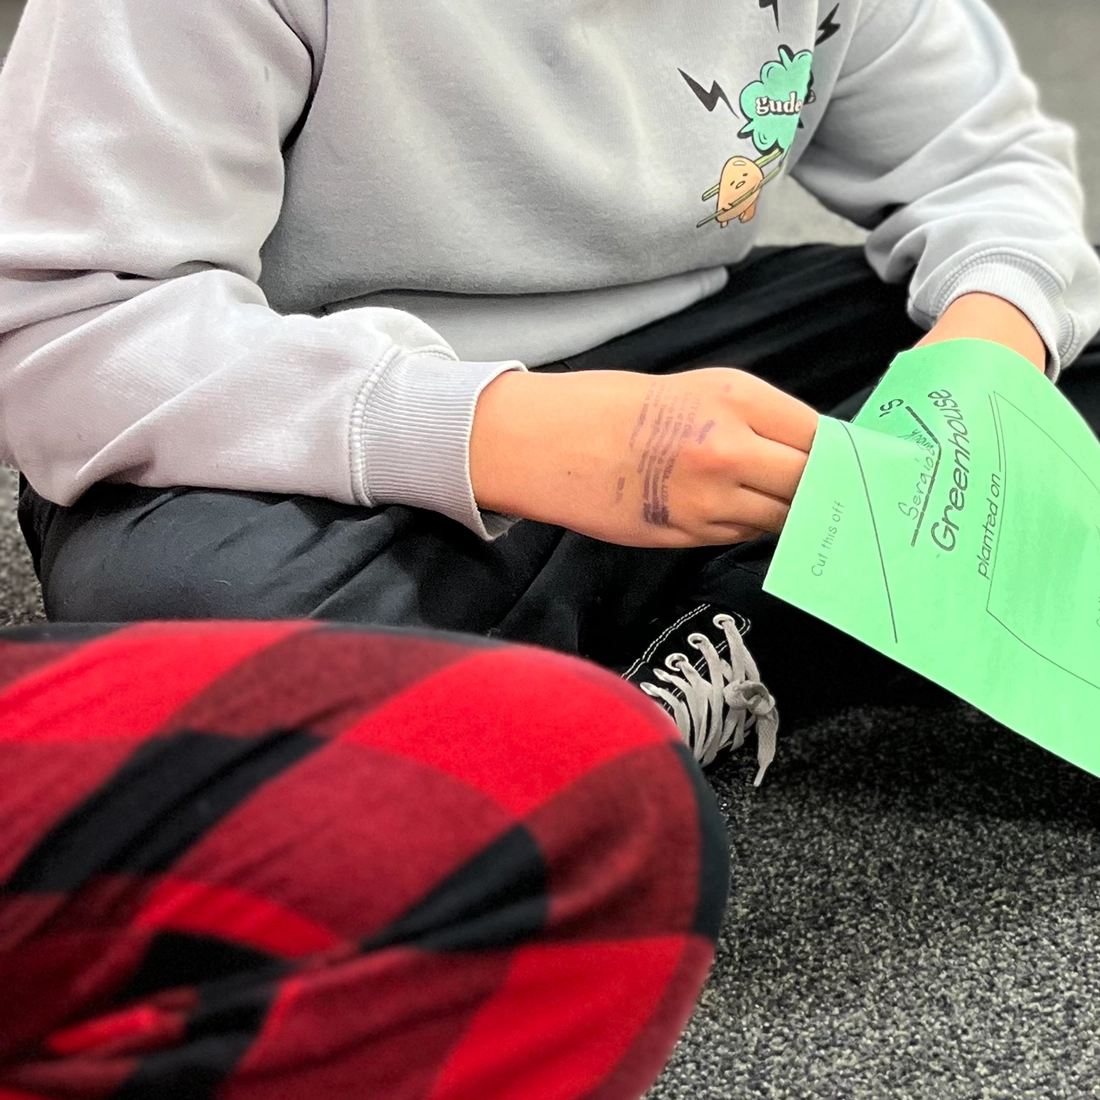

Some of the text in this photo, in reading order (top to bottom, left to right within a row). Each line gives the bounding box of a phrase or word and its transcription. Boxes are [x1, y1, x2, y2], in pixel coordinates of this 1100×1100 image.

[927, 389, 971, 552] Greenhouse
[811, 500, 845, 577] Cut this off
[976, 473, 1001, 581] planted on
